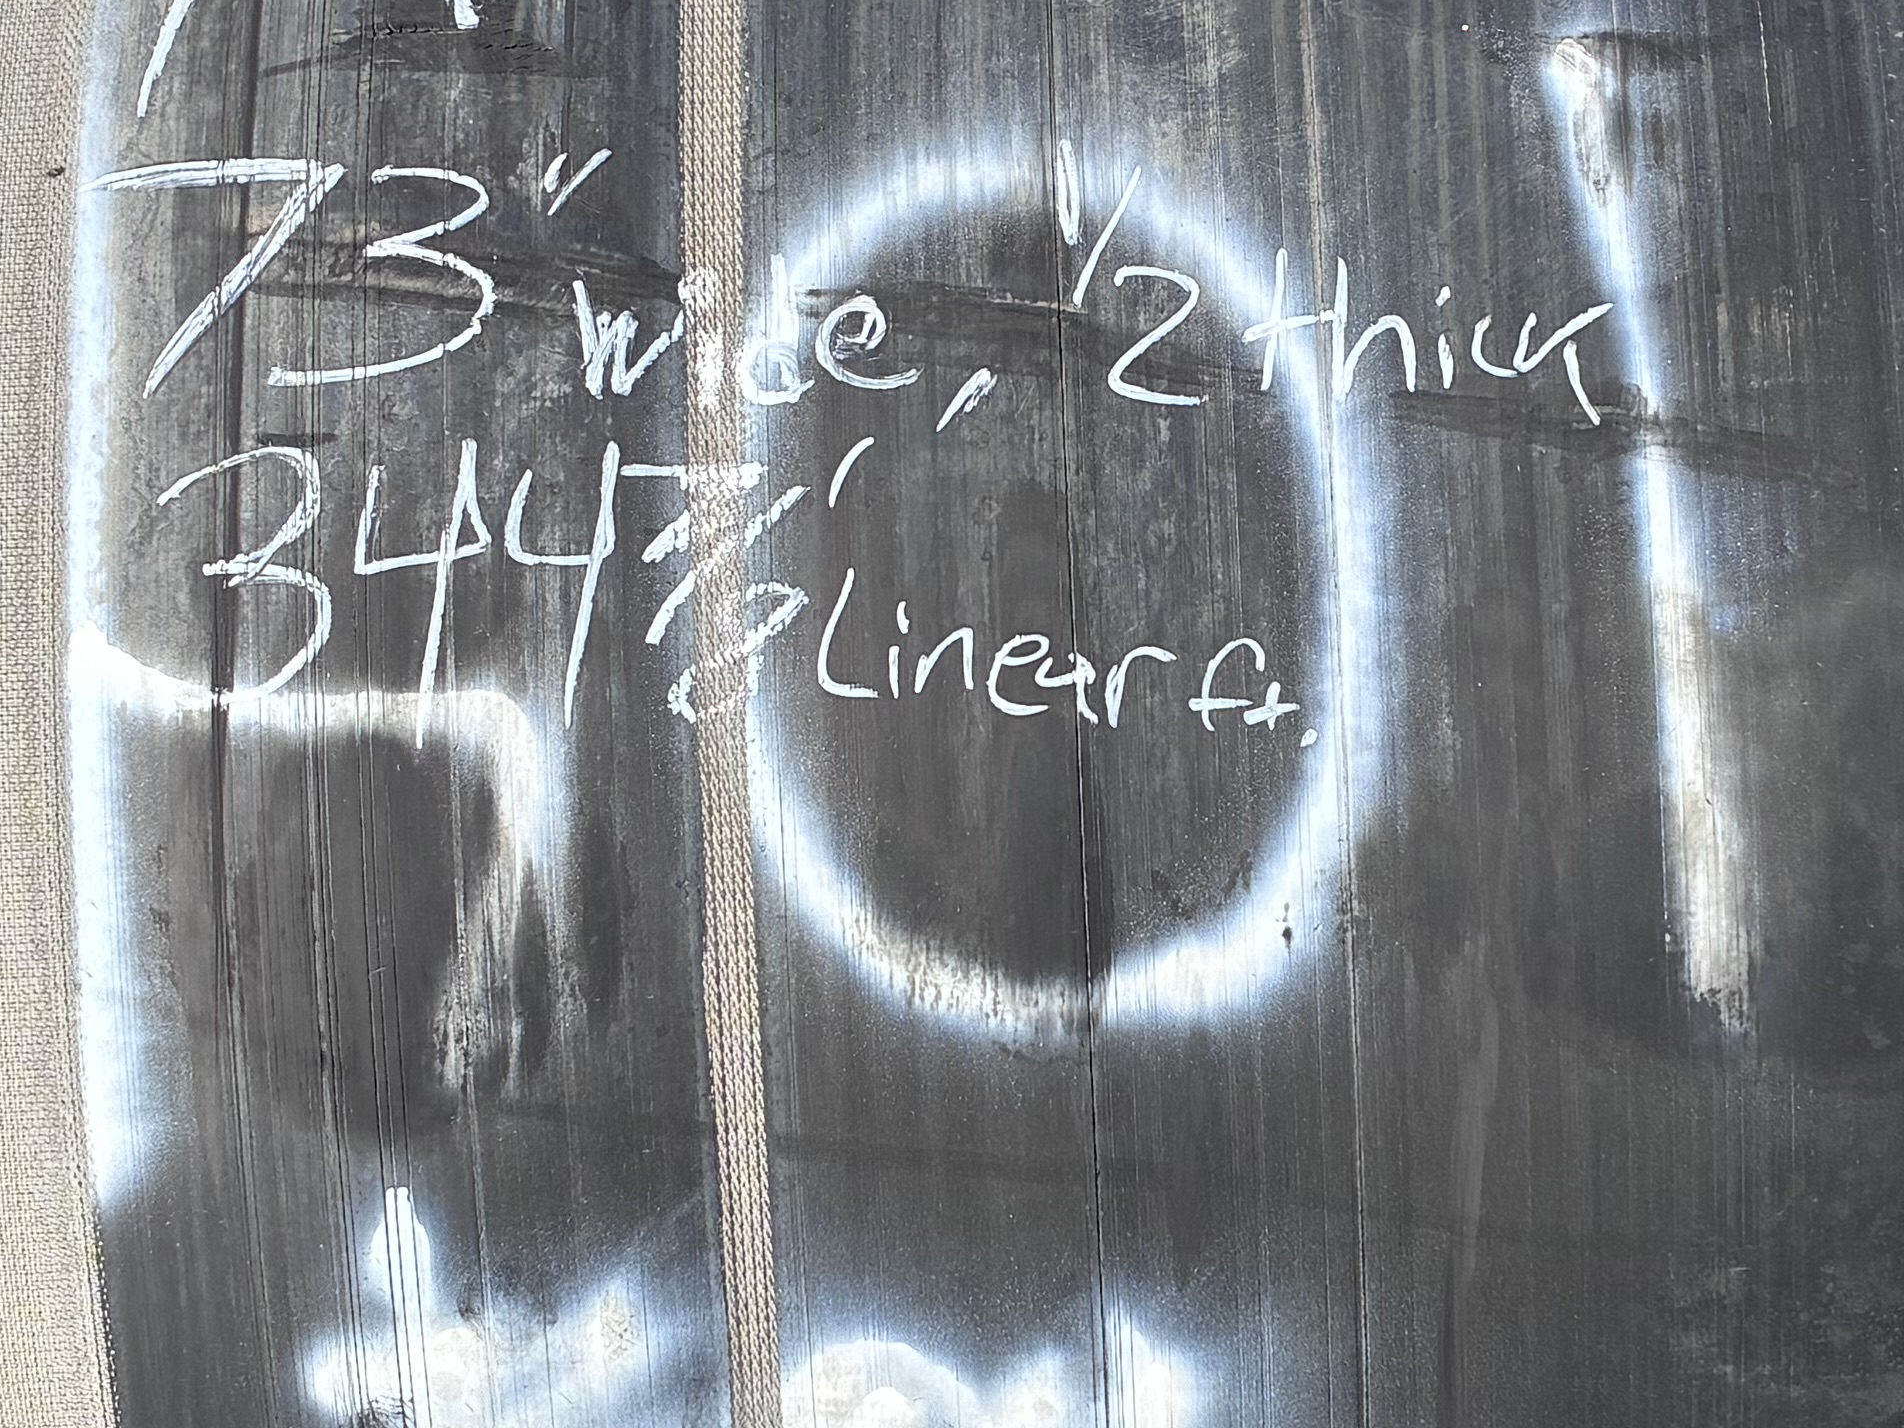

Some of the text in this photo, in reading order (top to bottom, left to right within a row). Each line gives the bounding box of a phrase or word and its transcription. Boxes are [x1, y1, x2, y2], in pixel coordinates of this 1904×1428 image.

[77, 148, 613, 400] 73"
[1242, 247, 1613, 425] thick
[818, 569, 1177, 729] Linear
